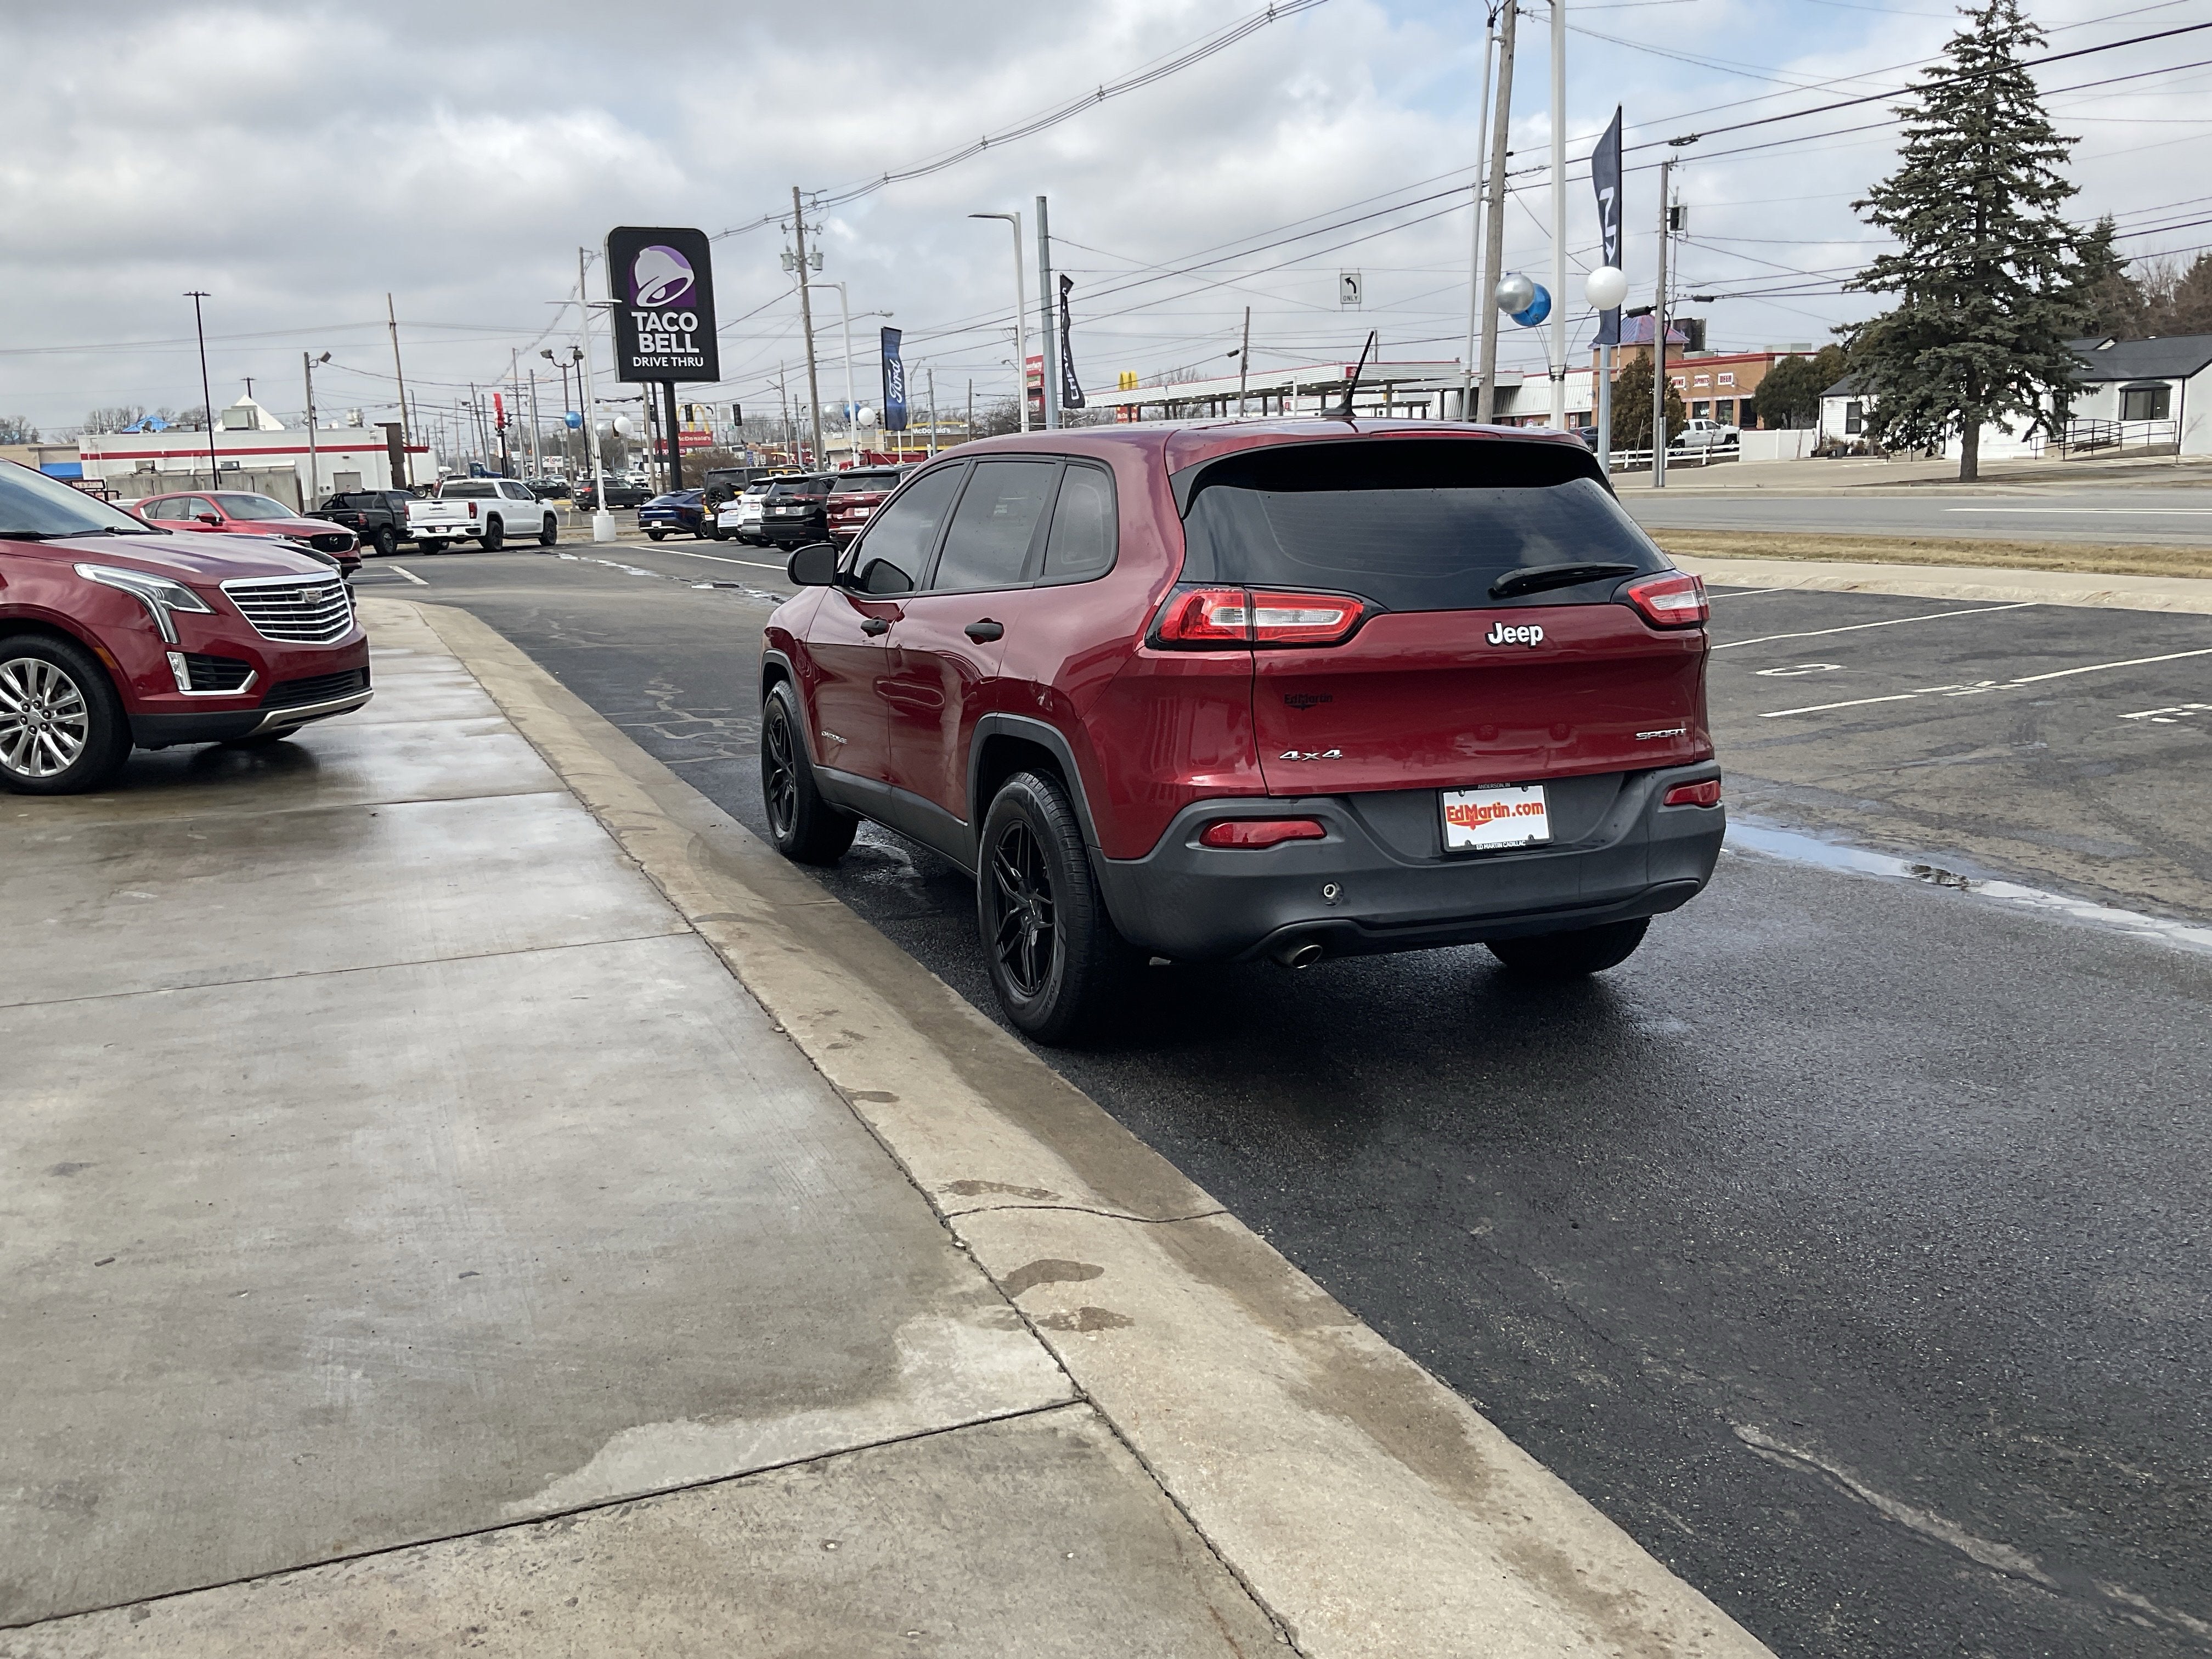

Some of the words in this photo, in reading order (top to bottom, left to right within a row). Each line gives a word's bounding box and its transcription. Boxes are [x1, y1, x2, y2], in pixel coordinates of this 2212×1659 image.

[631, 311, 698, 332] TACO
[638, 333, 699, 353] BELL
[633, 357, 669, 366] DRIVE
[670, 357, 704, 366] THRU
[887, 358, 902, 404] Ford
[1672, 378, 1684, 386] WINE
[1485, 621, 1544, 648] Jeep
[1635, 728, 1687, 741] SPORT
[1279, 749, 1342, 761] 4x4
